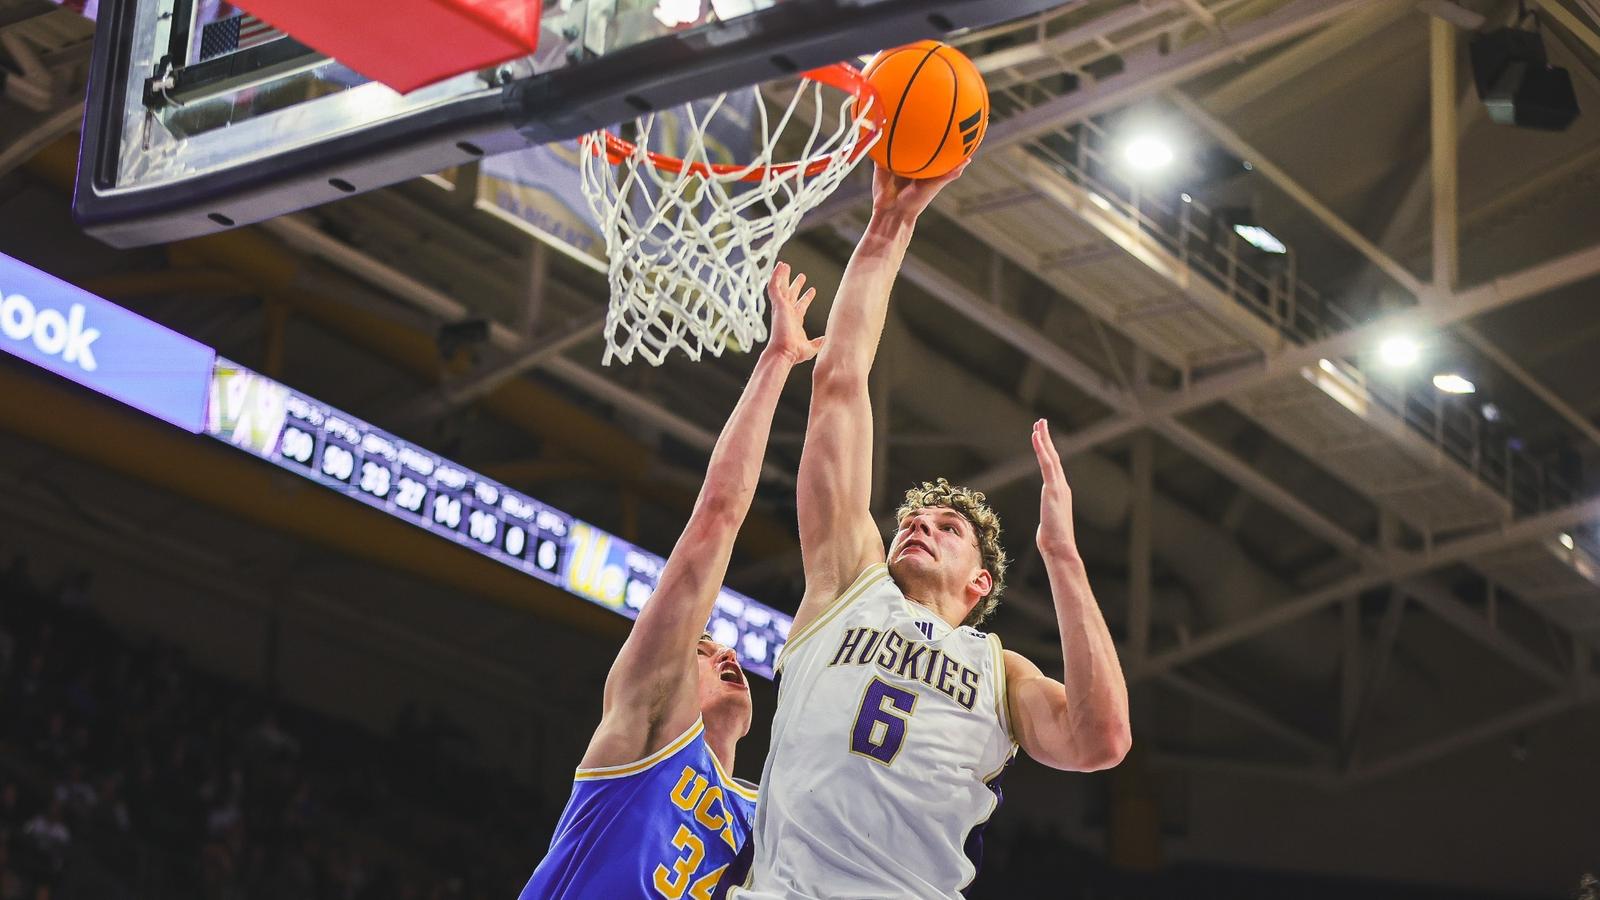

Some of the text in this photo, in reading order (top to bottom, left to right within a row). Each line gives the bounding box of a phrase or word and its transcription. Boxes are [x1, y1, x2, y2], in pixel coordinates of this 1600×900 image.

[0, 292, 101, 372] ook
[827, 626, 980, 713] HUSKIES
[849, 675, 919, 768] 6
